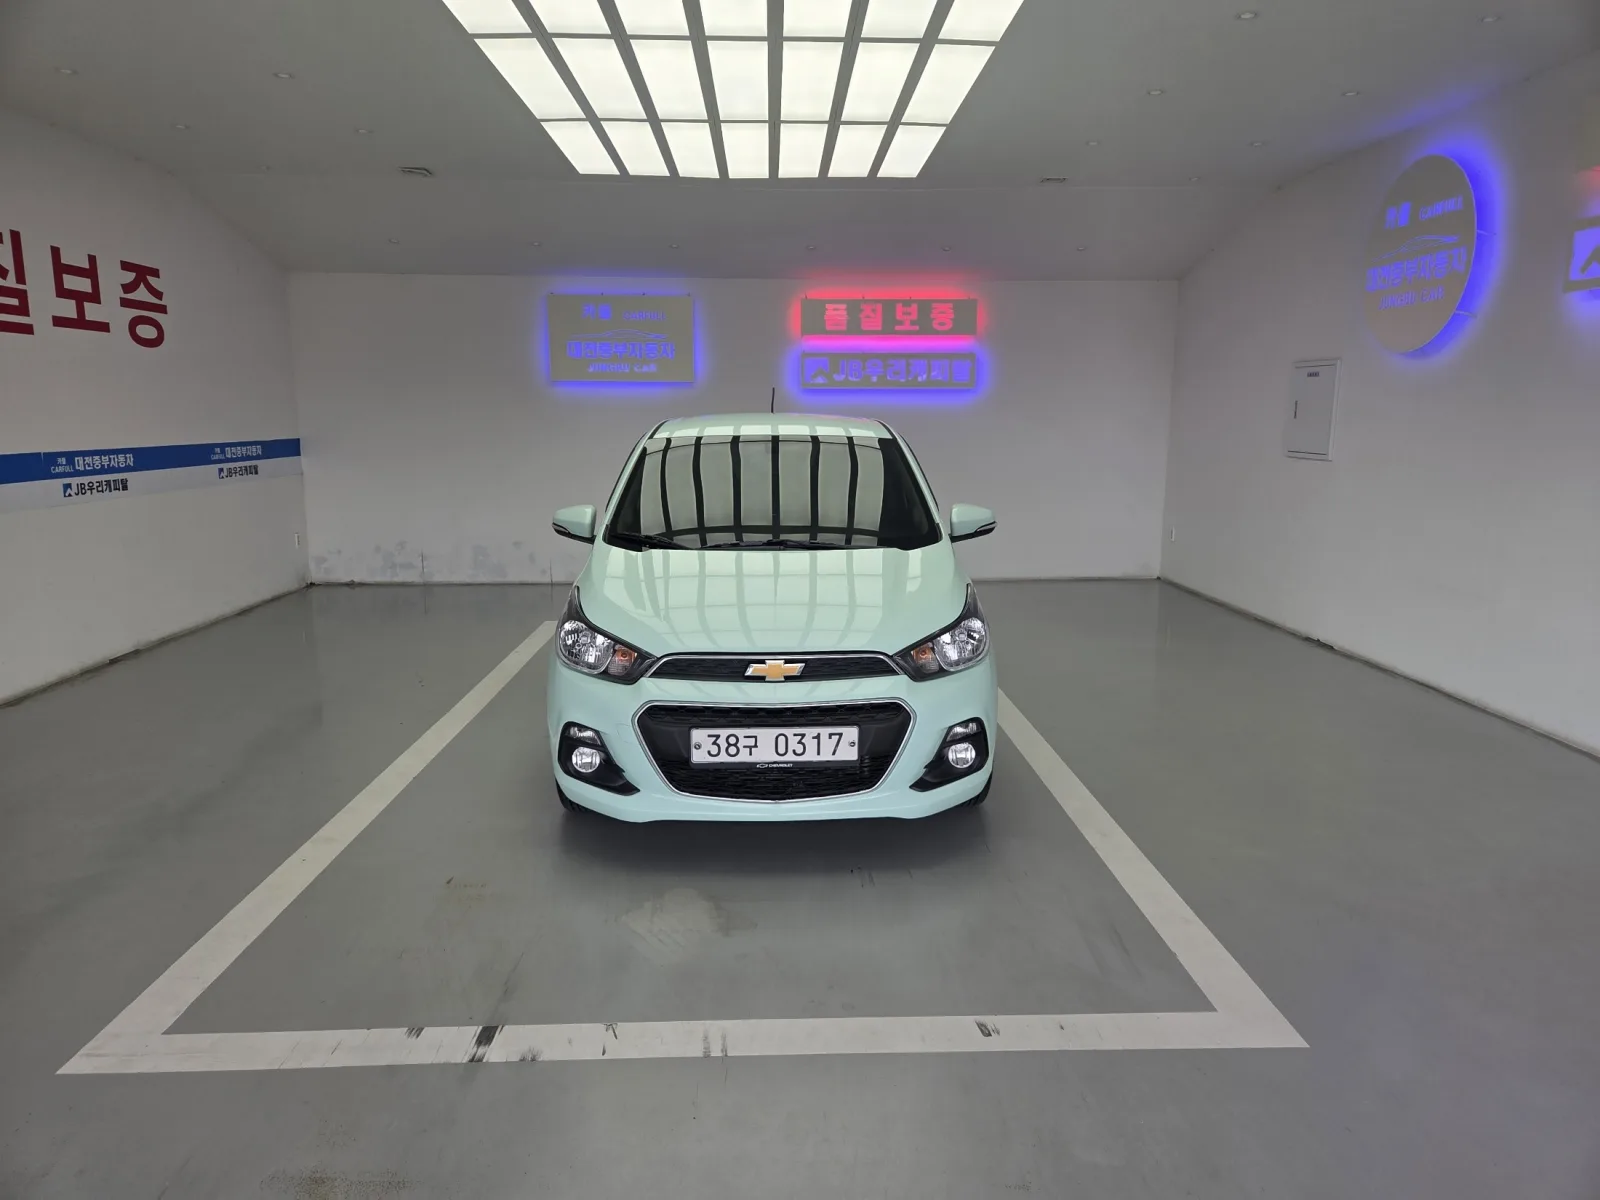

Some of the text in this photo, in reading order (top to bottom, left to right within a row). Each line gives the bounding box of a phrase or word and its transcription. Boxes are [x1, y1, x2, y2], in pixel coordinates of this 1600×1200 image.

[74, 453, 134, 471] 대전중부자동차
[74, 478, 129, 496] JB우리캐피탈
[707, 732, 844, 757] 38구 0317
